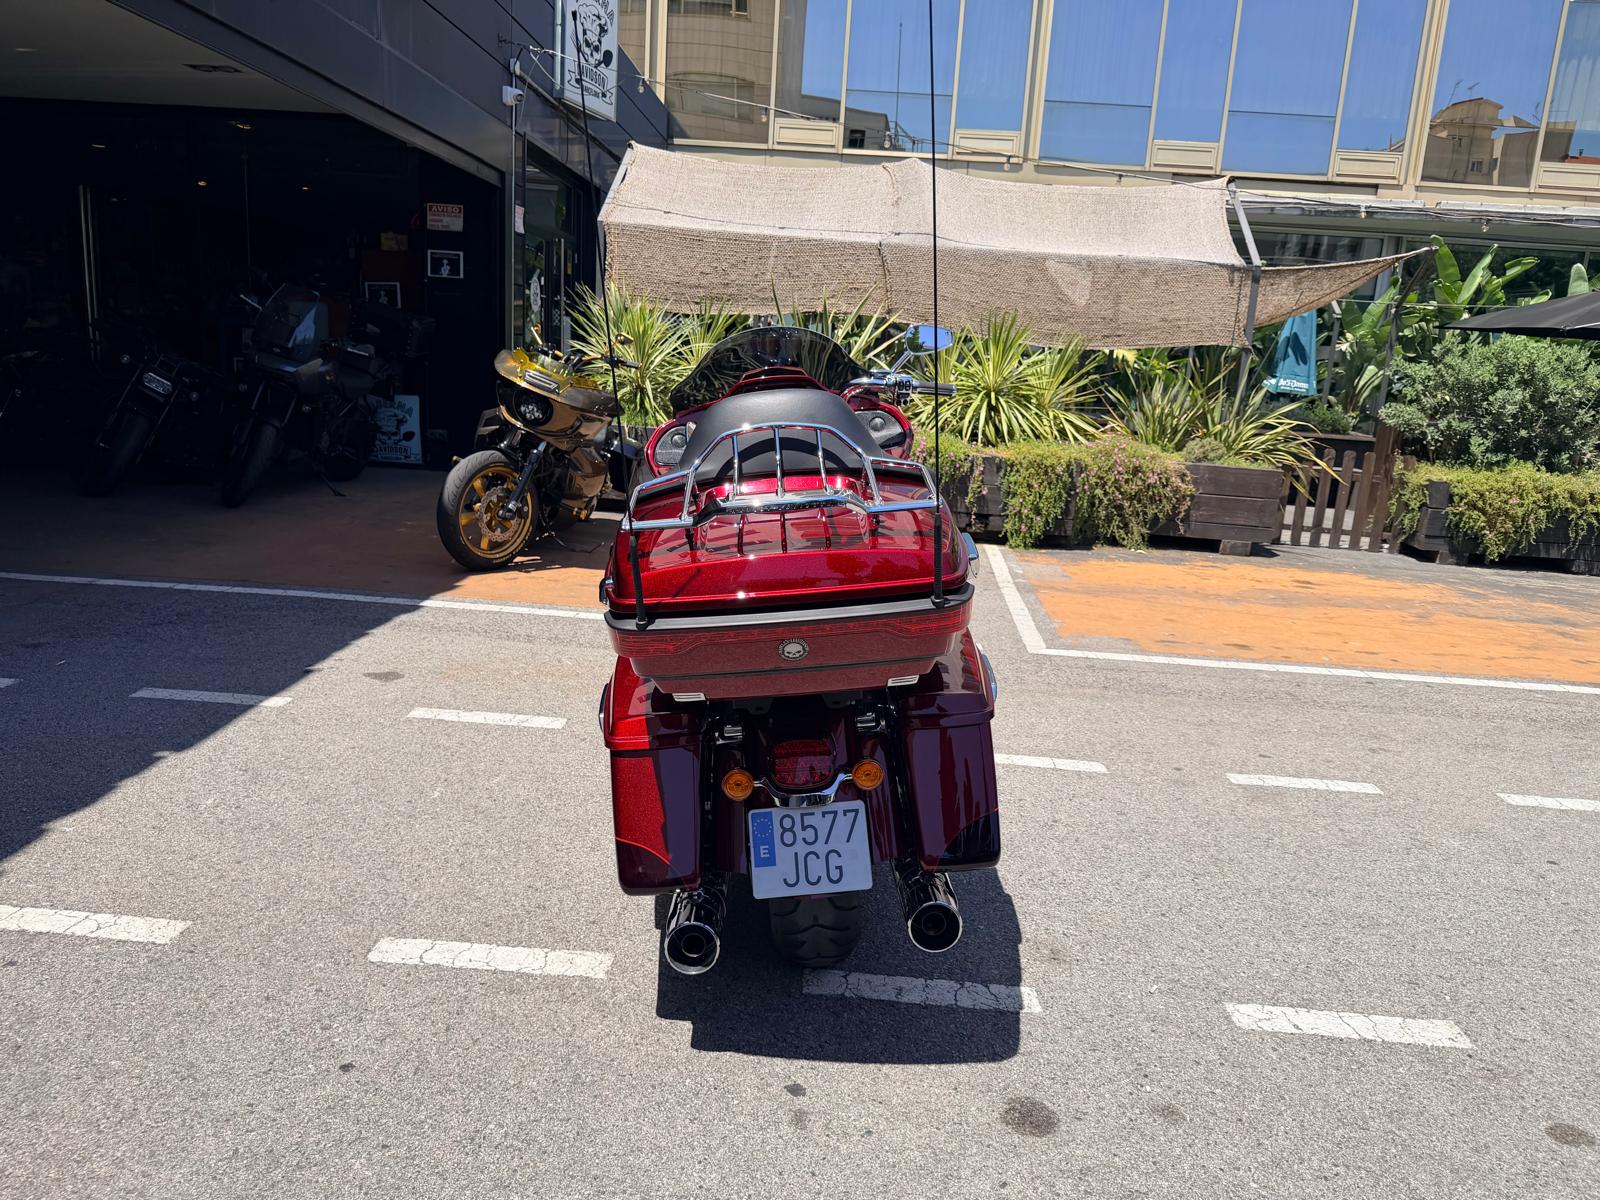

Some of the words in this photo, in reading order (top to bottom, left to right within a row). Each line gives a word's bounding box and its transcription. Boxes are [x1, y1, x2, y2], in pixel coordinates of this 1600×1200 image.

[431, 205, 460, 214] AVISO
[779, 808, 860, 847] 8577
[759, 845, 770, 858] E
[783, 849, 843, 888] JCG
